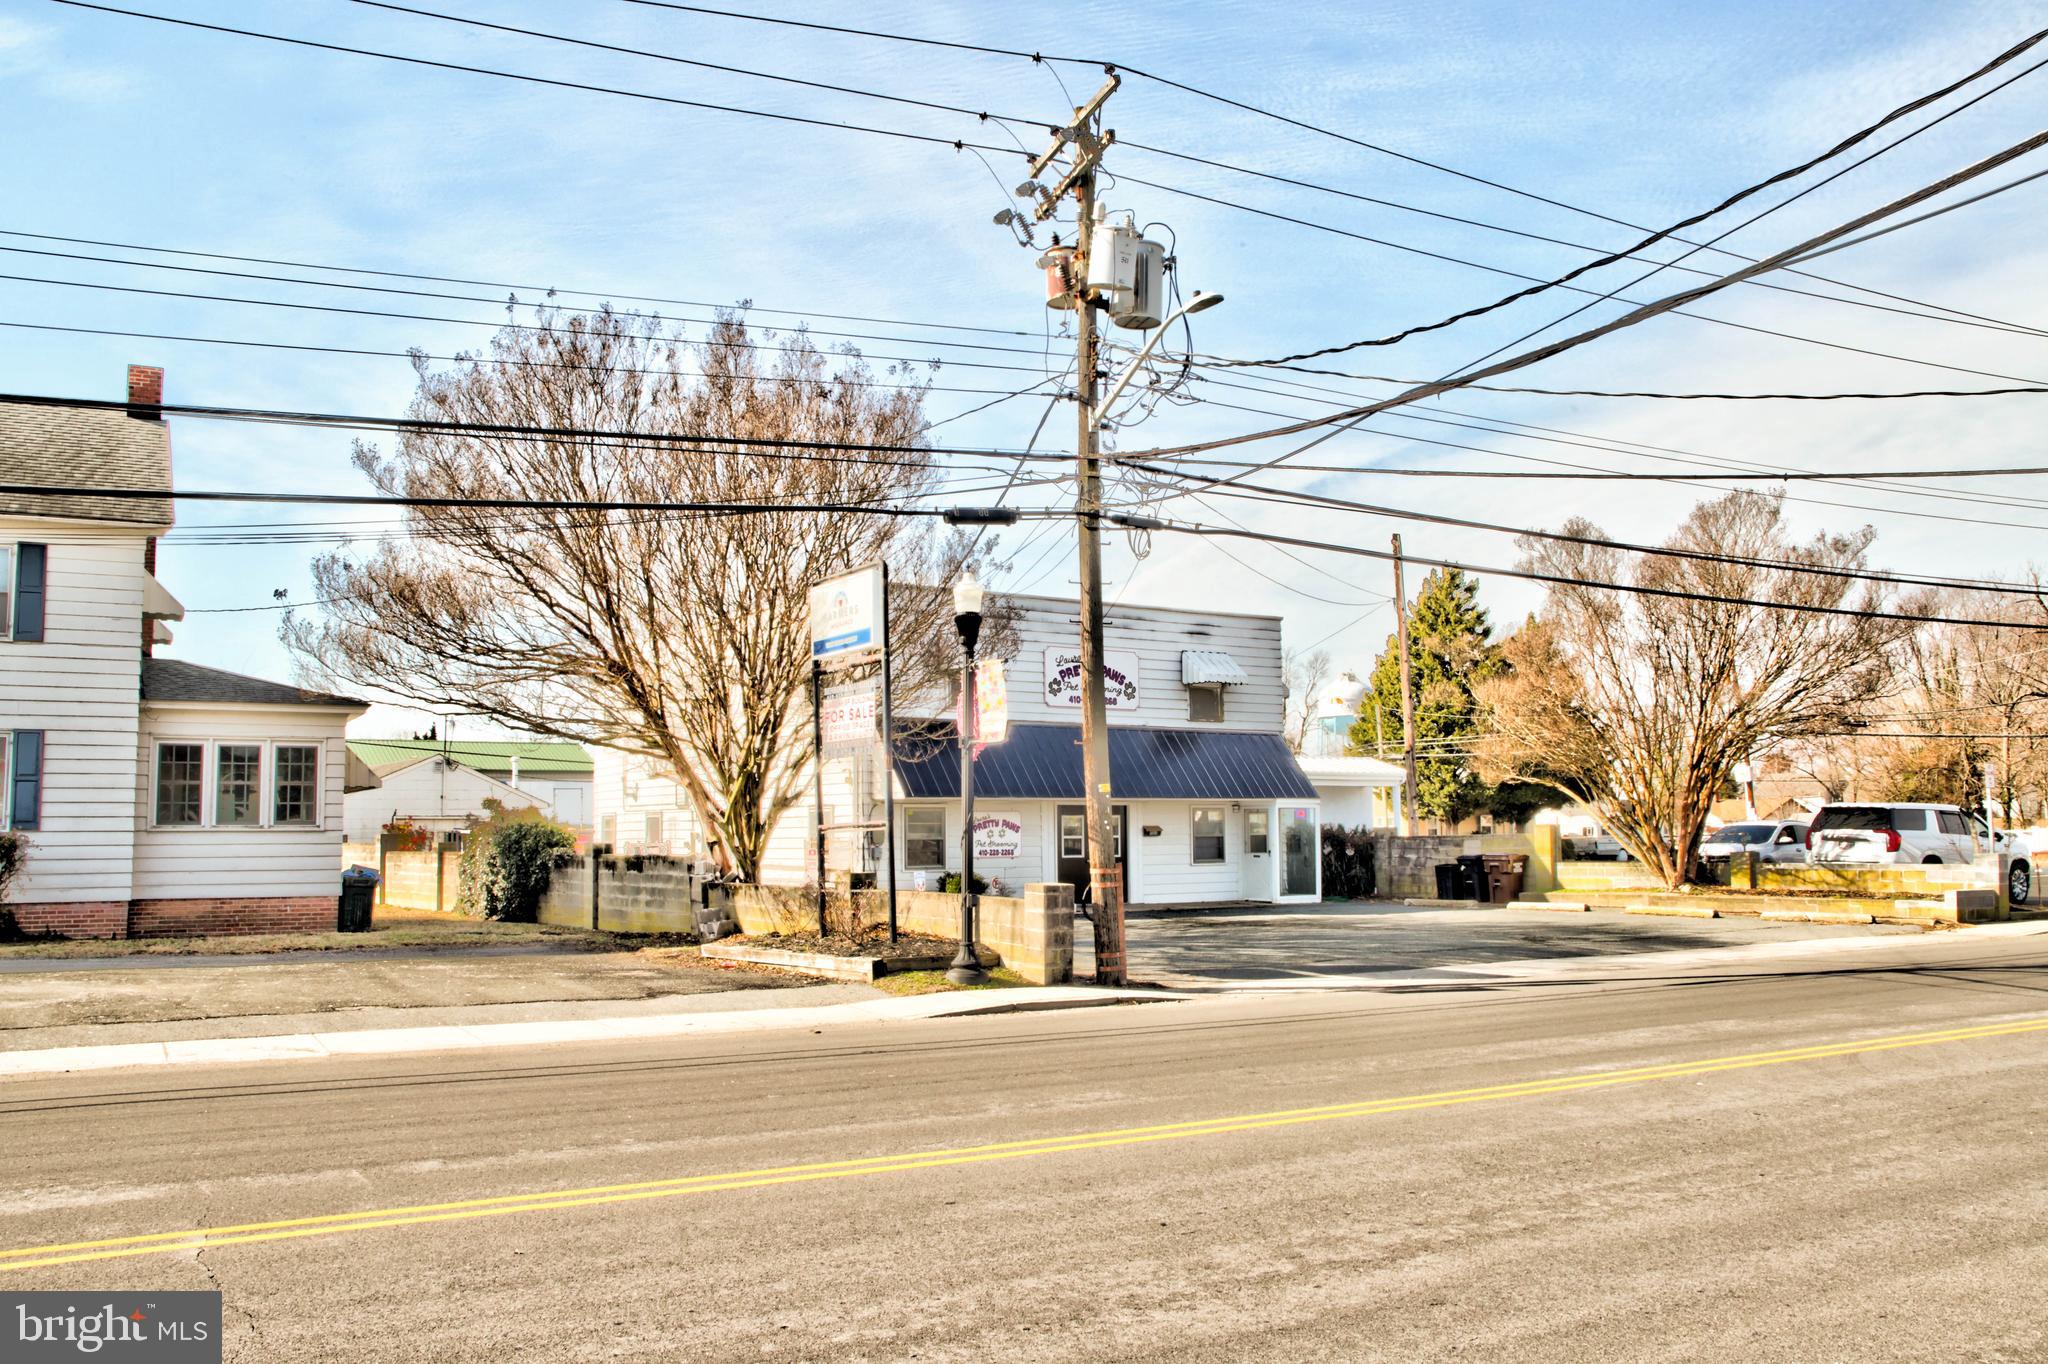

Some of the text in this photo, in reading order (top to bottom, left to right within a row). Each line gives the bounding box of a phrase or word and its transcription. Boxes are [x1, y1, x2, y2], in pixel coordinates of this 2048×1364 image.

[825, 704, 874, 723] FOR SALE
[972, 819, 1021, 833] PRETTY PAWS
[974, 839, 987, 848] Pet
